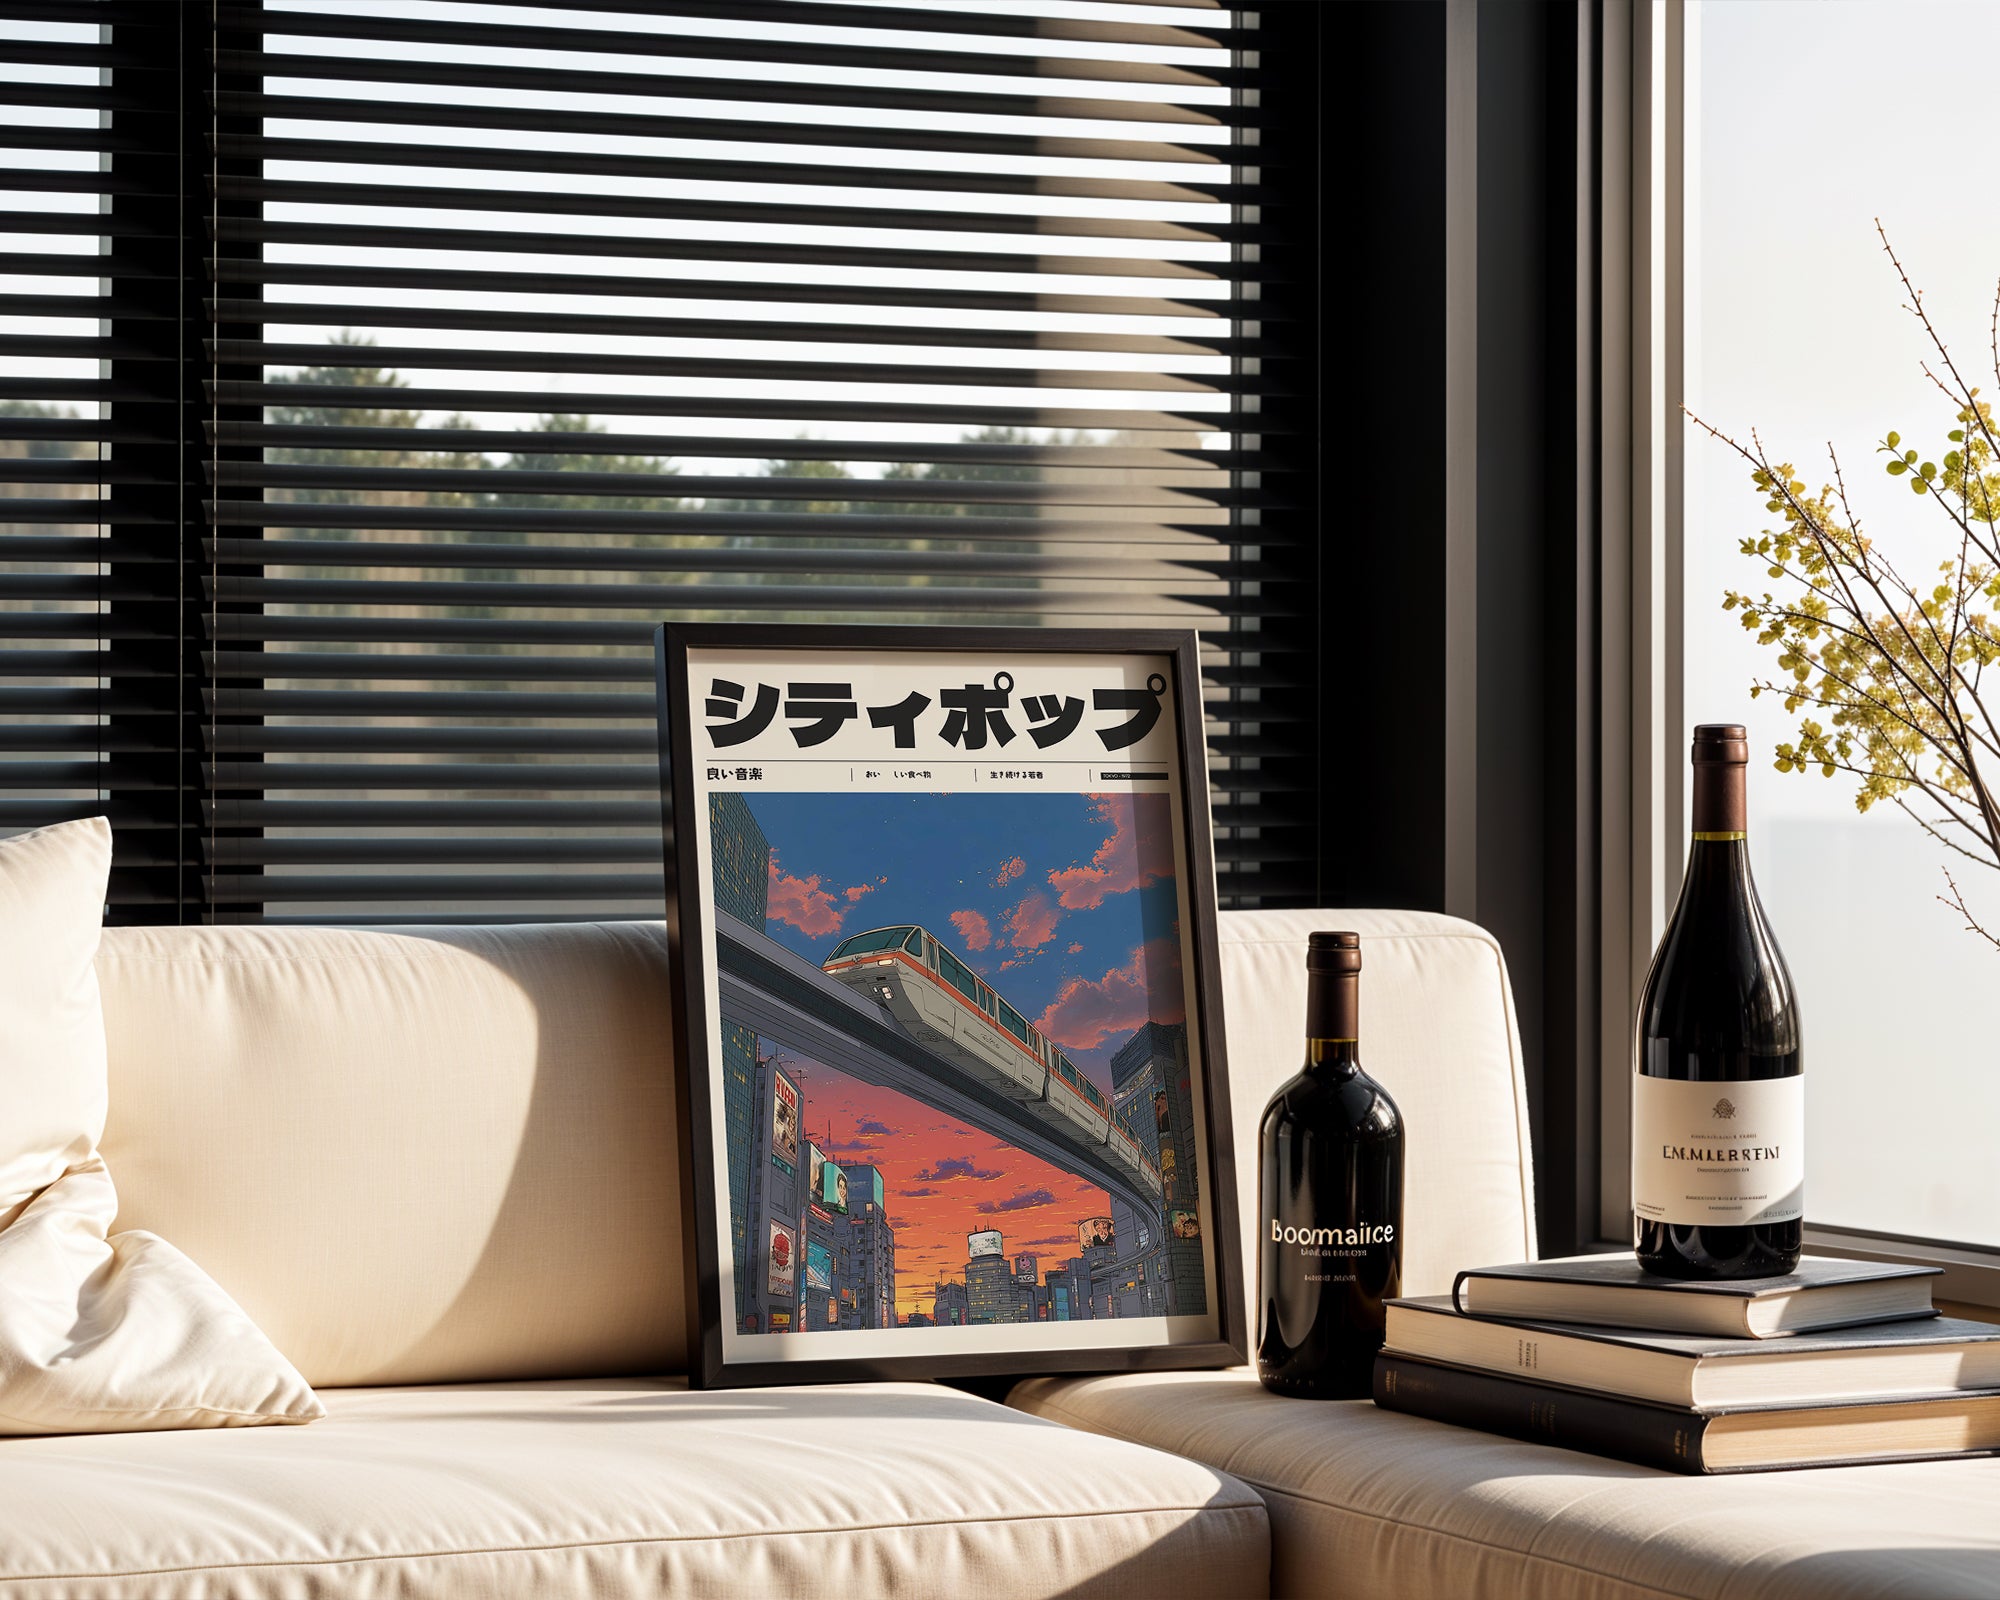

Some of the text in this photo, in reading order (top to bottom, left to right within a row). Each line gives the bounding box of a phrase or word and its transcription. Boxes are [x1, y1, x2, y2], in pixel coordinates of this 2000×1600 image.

[704, 671, 1167, 752] シティポップ
[706, 767, 763, 780] 良い音楽
